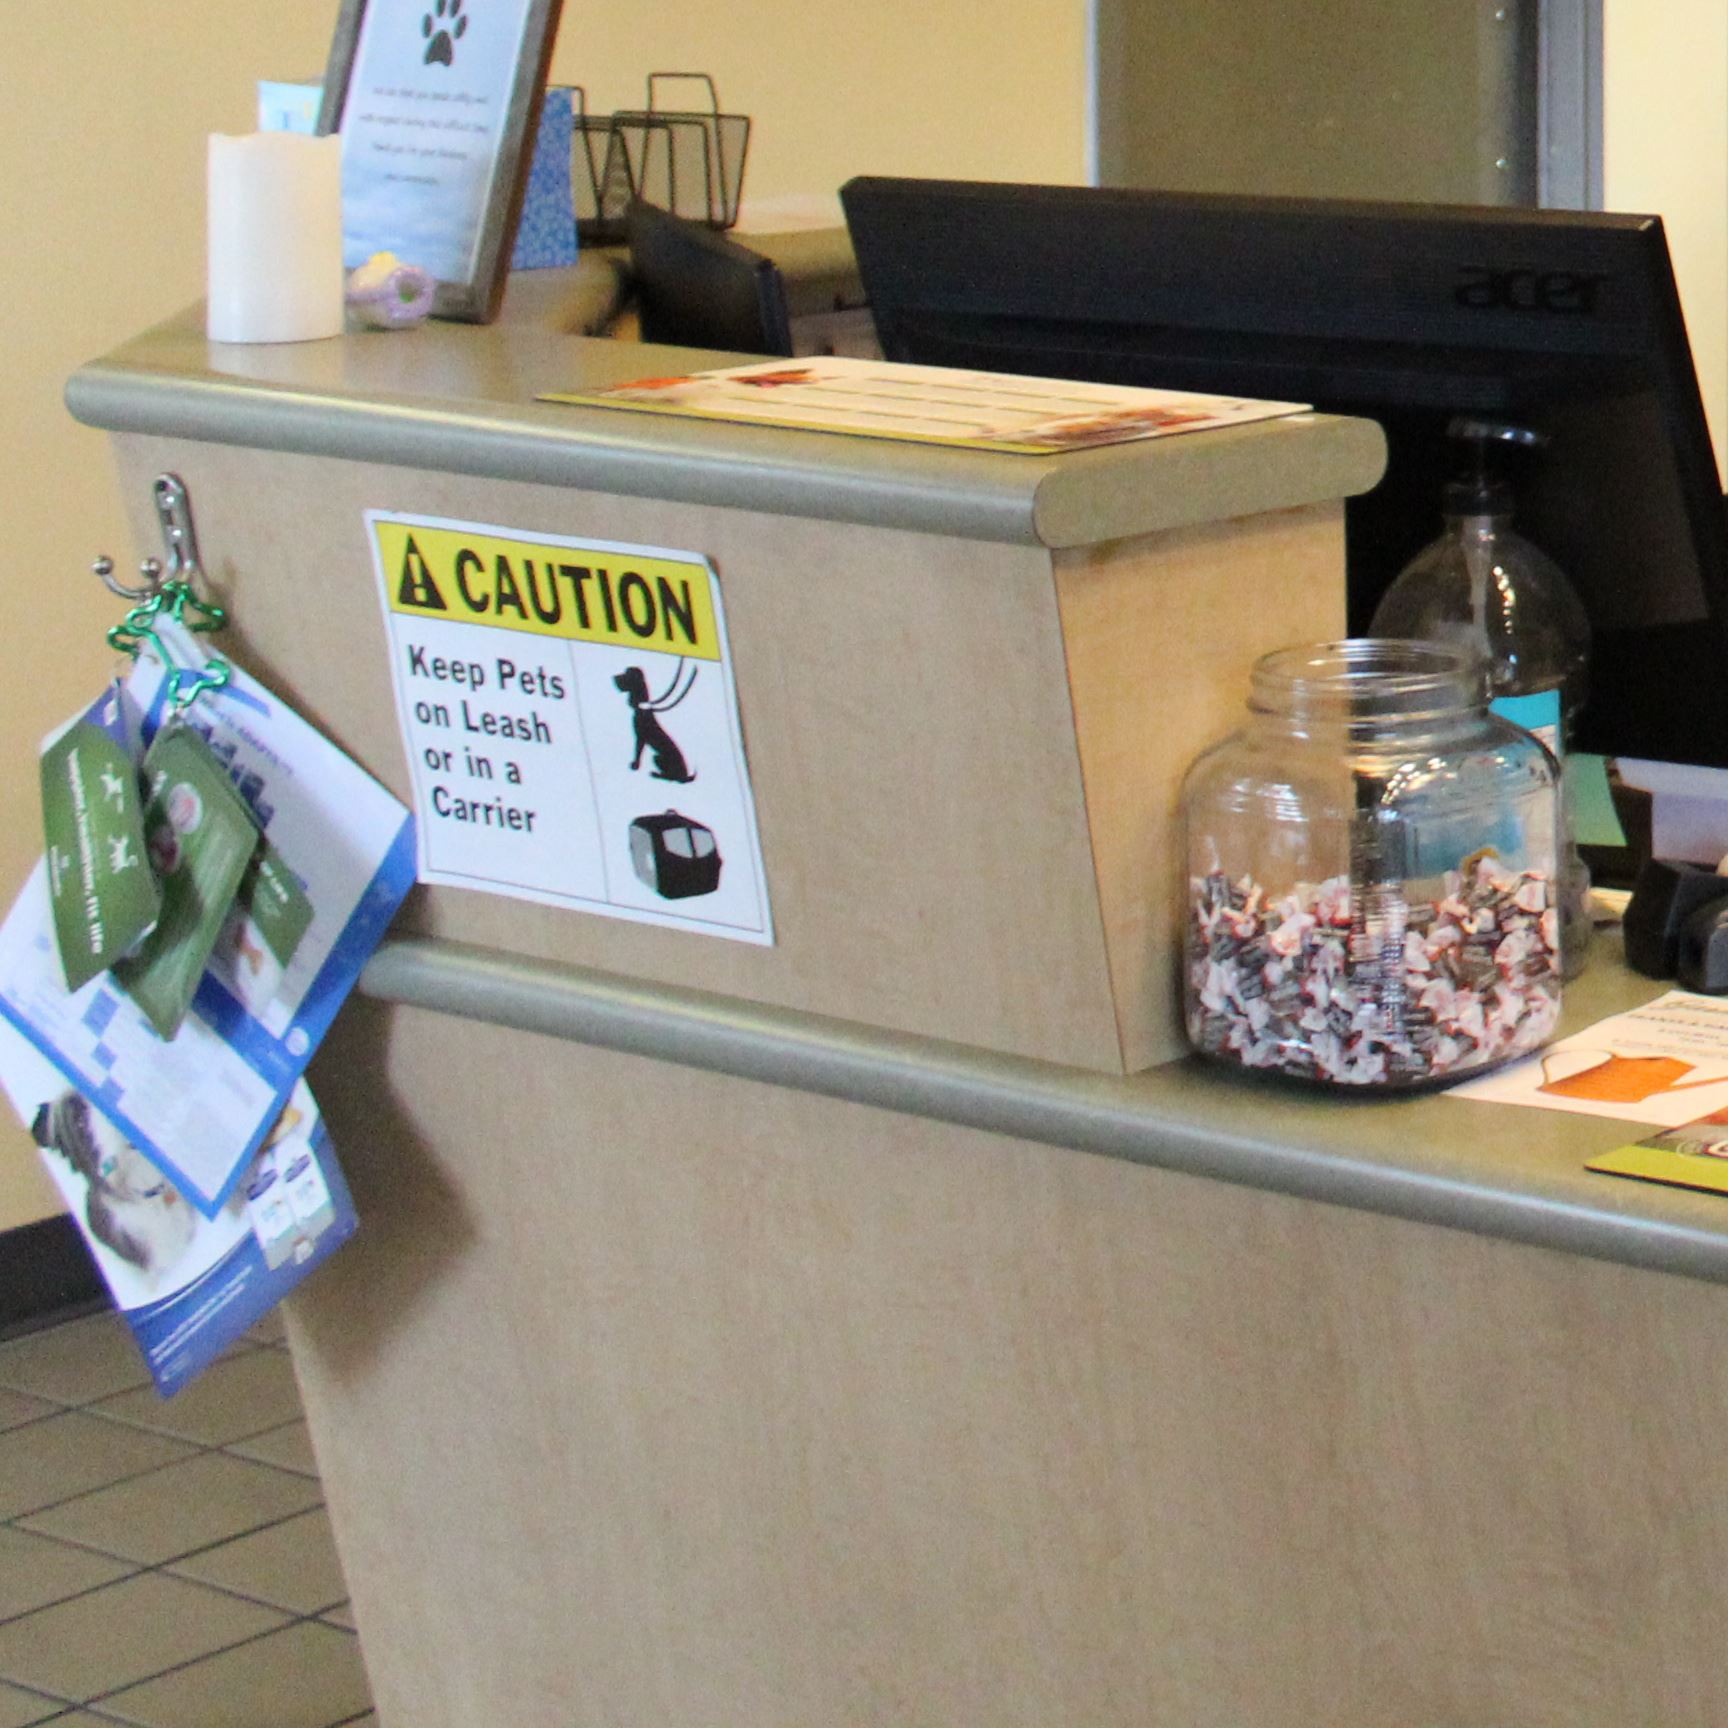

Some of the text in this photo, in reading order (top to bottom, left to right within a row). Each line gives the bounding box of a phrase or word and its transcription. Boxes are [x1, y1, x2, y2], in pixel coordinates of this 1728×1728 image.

[1455, 265, 1608, 314] acer
[454, 547, 698, 645] CAUTION
[408, 644, 565, 700] Keep Pets
[416, 700, 552, 744] on Leash
[424, 746, 522, 785] or in a
[431, 784, 537, 833] Carrier
